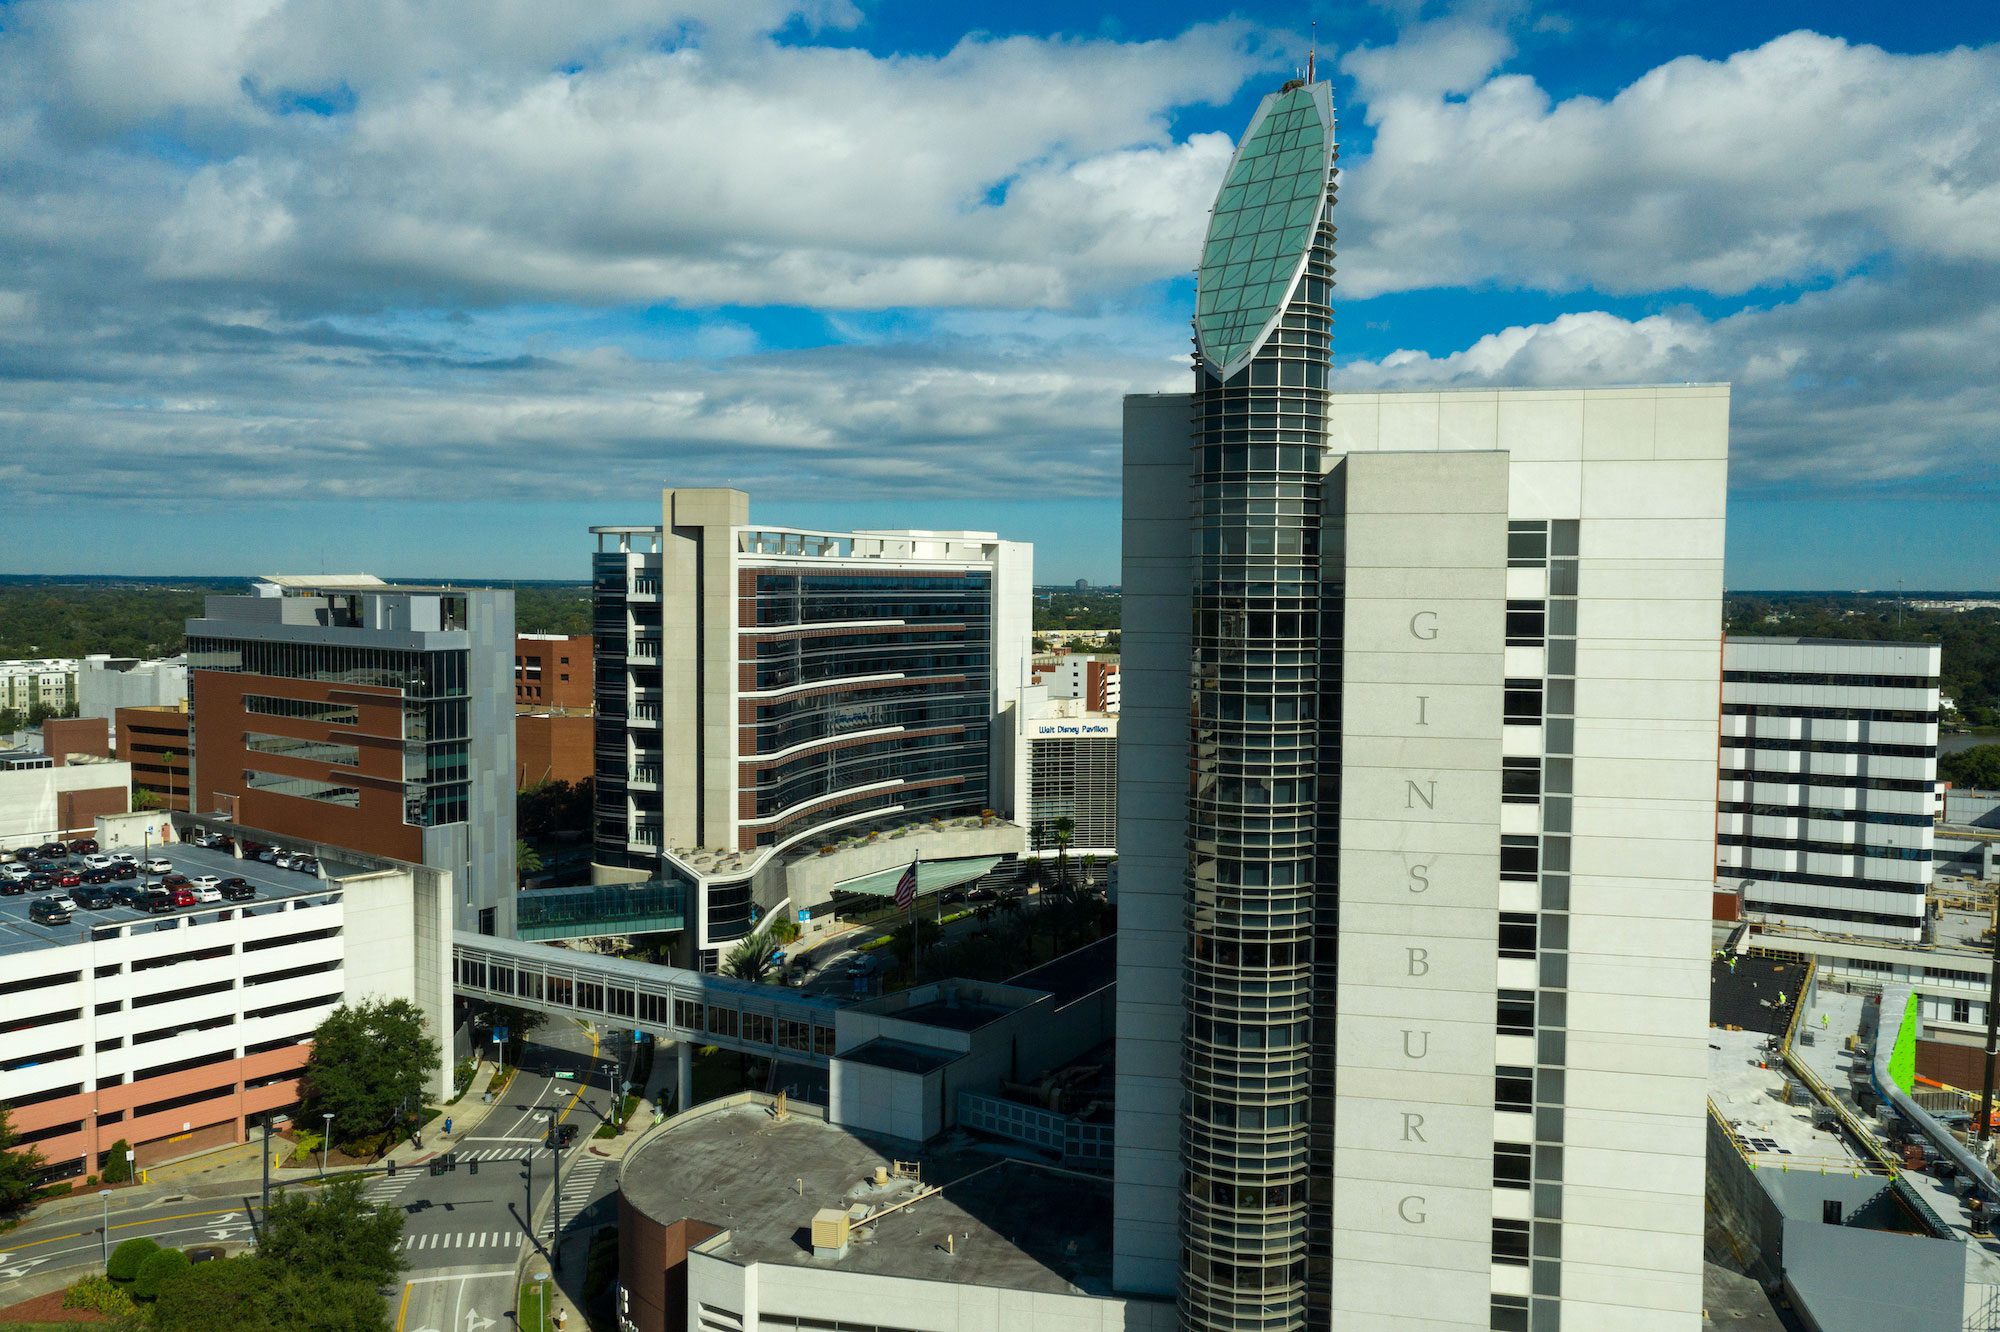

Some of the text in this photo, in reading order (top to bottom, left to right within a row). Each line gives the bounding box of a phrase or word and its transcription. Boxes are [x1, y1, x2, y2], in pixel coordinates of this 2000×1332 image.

[1039, 725, 1109, 735] Walt Disney Pavilion
[1398, 611, 1439, 1224] GINSBURG
